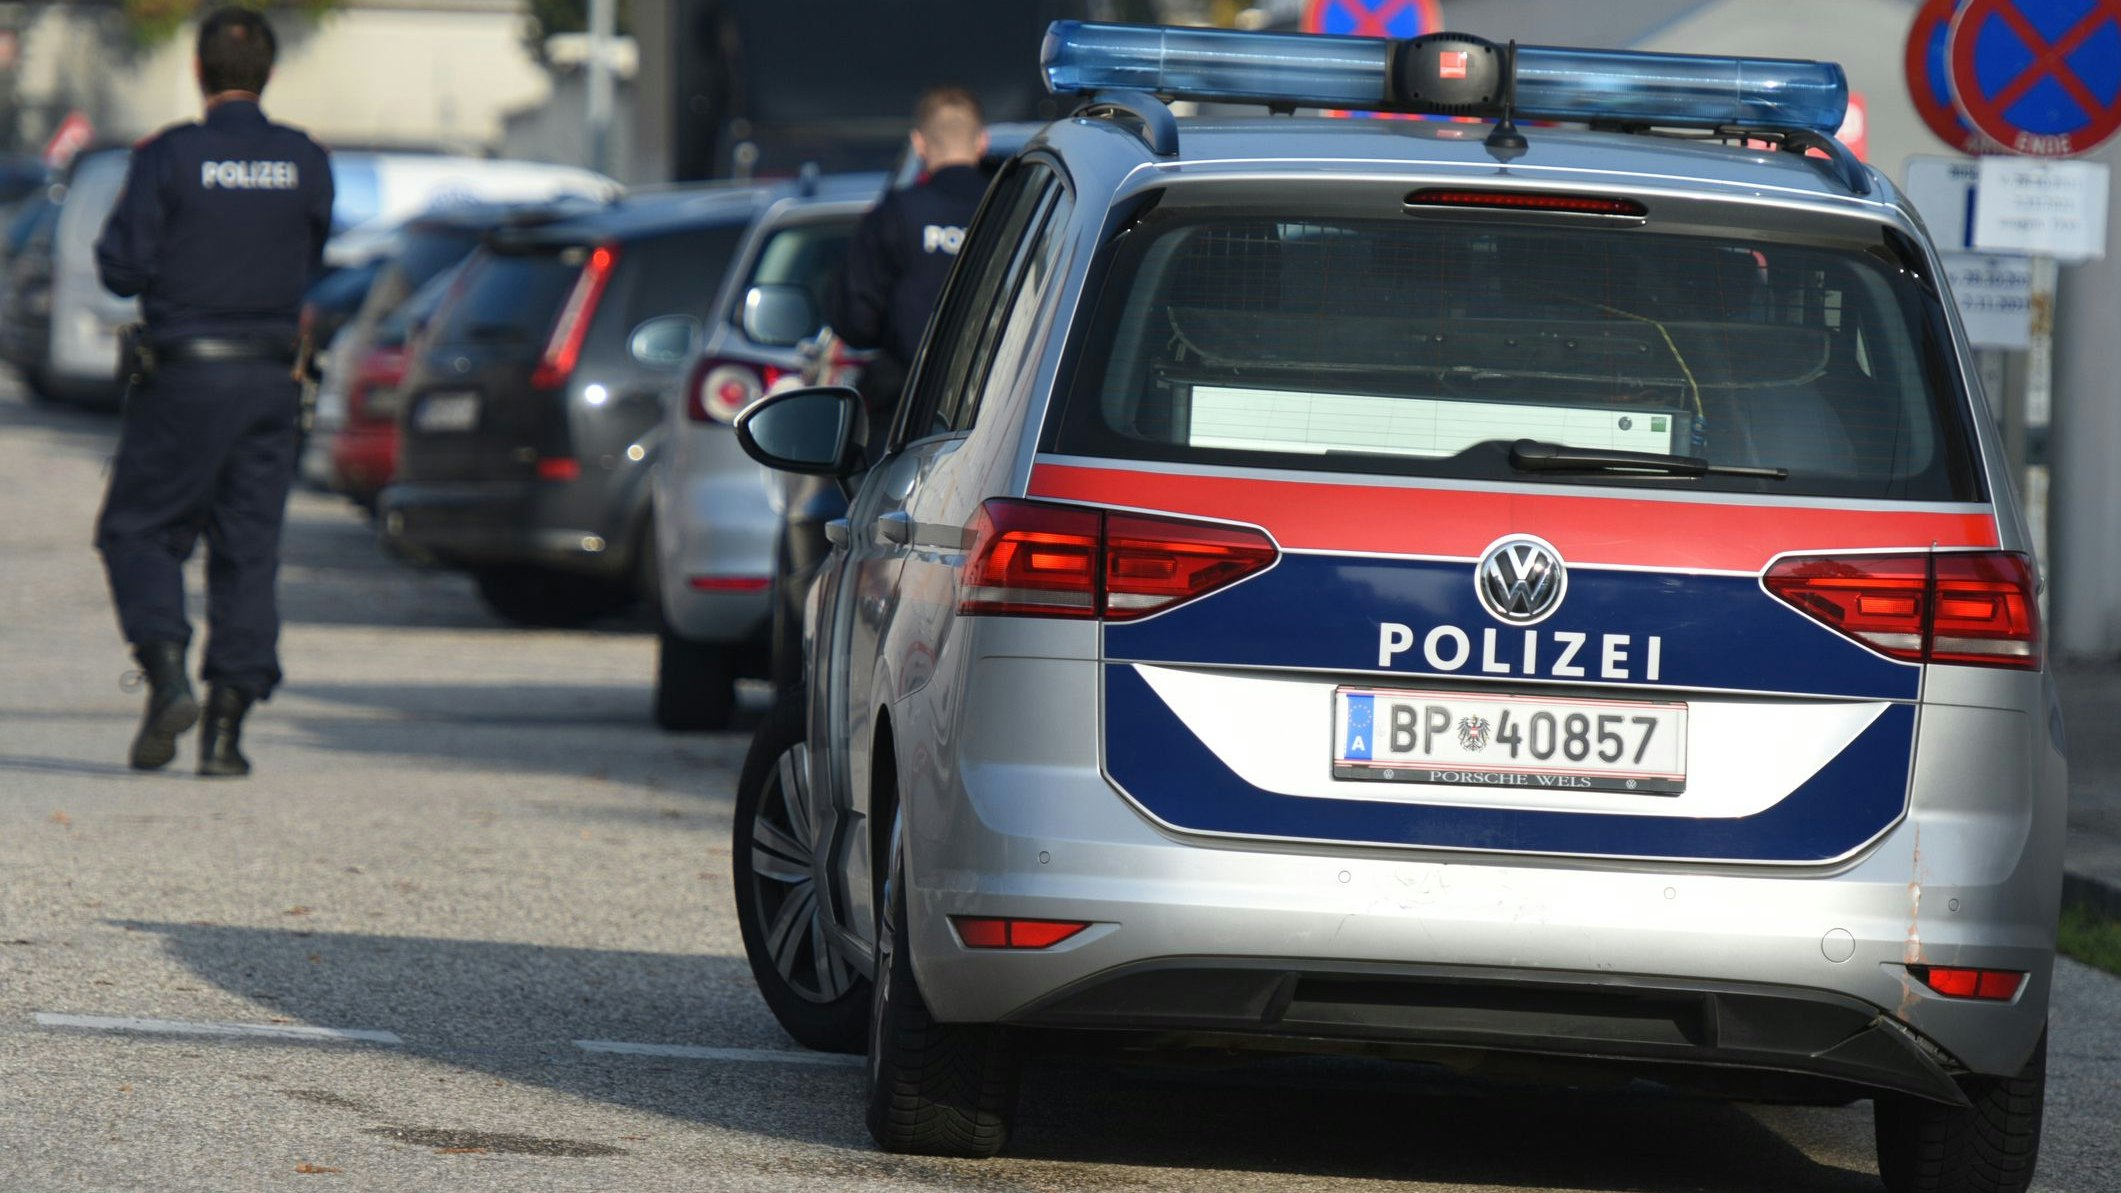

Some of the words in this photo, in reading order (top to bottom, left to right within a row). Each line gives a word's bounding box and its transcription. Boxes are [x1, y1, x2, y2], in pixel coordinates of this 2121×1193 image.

[2014, 132, 2073, 155] ENDE
[202, 160, 299, 190] POLIZEI
[923, 225, 967, 254] PO
[1378, 622, 1661, 681] POLIZEI
[1351, 735, 1367, 752] A
[1390, 704, 1452, 755] BP
[1496, 709, 1659, 765] 40857
[1429, 770, 1529, 785] PORSCHE
[1536, 774, 1592, 788] WELS
